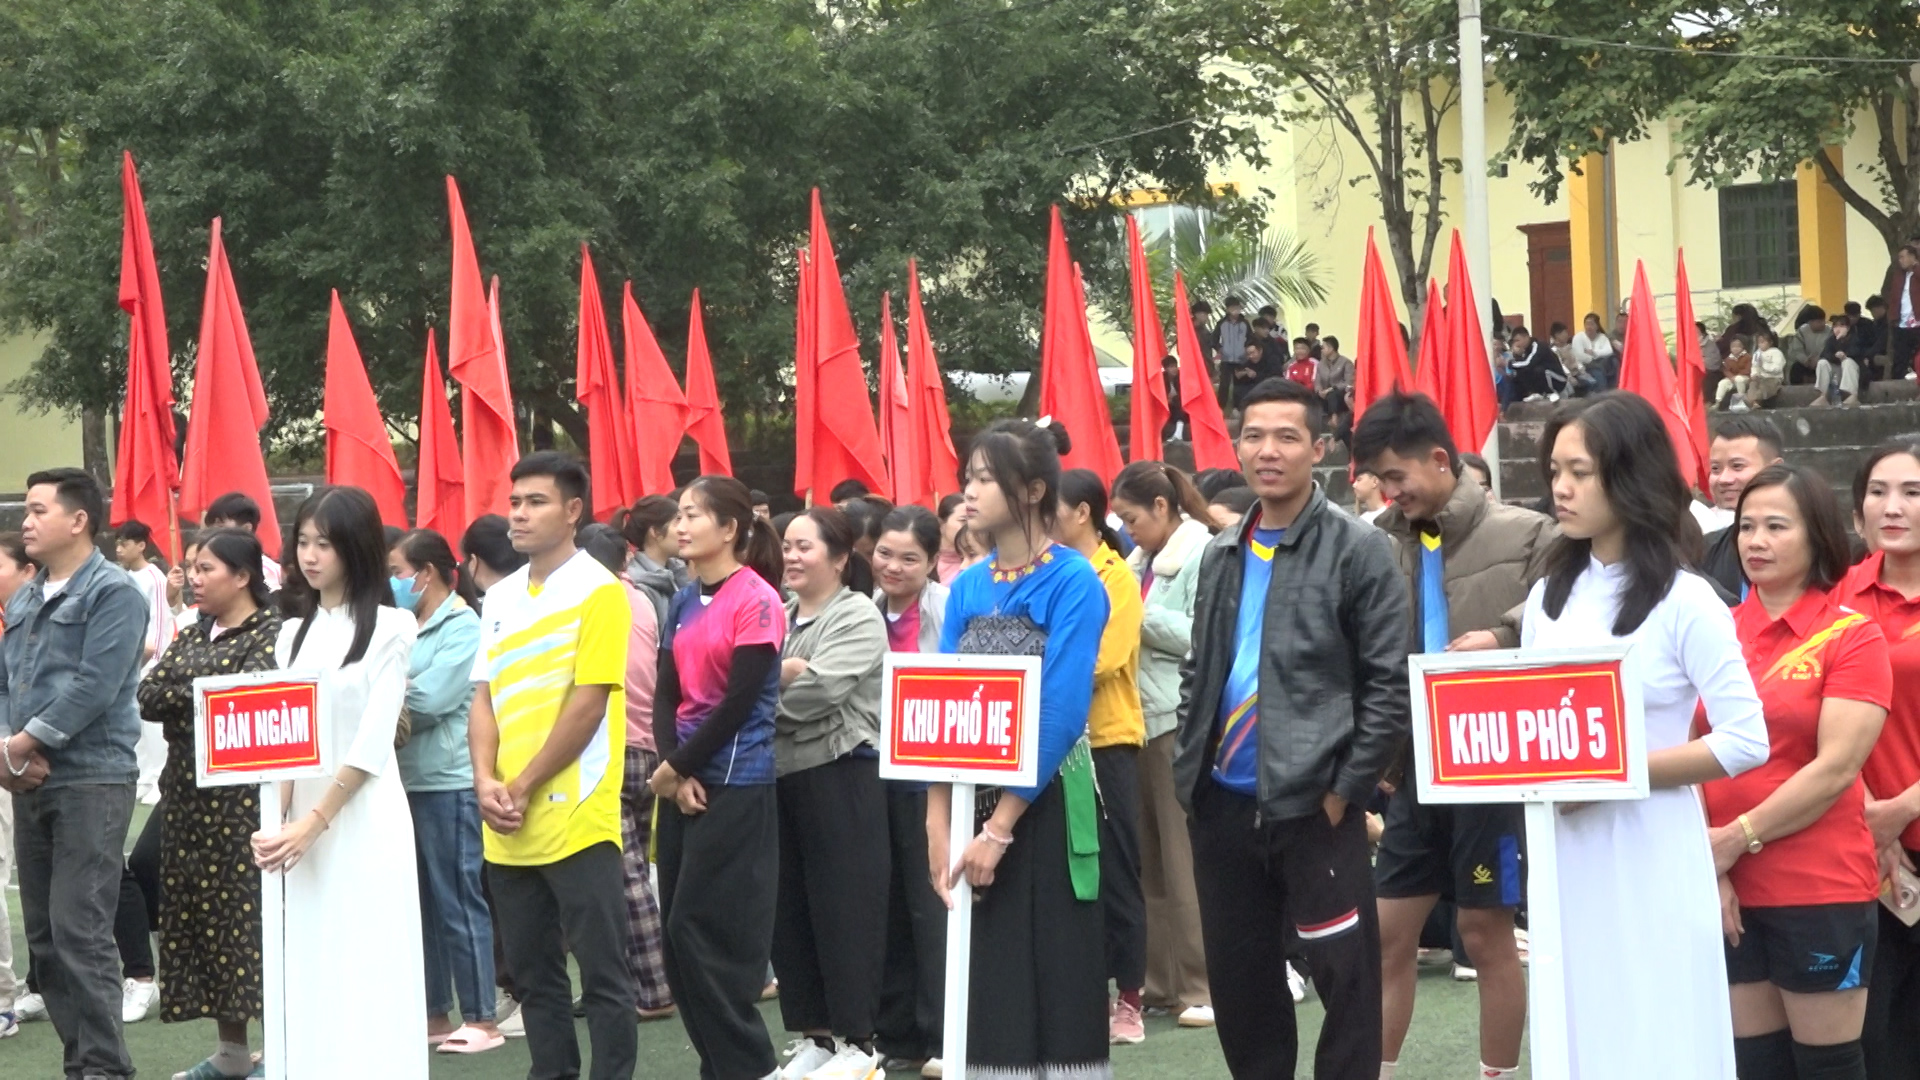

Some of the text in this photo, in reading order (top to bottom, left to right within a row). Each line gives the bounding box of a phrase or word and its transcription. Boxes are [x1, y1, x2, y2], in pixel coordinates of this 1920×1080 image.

[214, 700, 309, 750] BẢN NGÀM
[902, 684, 1013, 756] KHU PHỐ HẸ
[1449, 688, 1607, 765] KHU PHỐ 5
